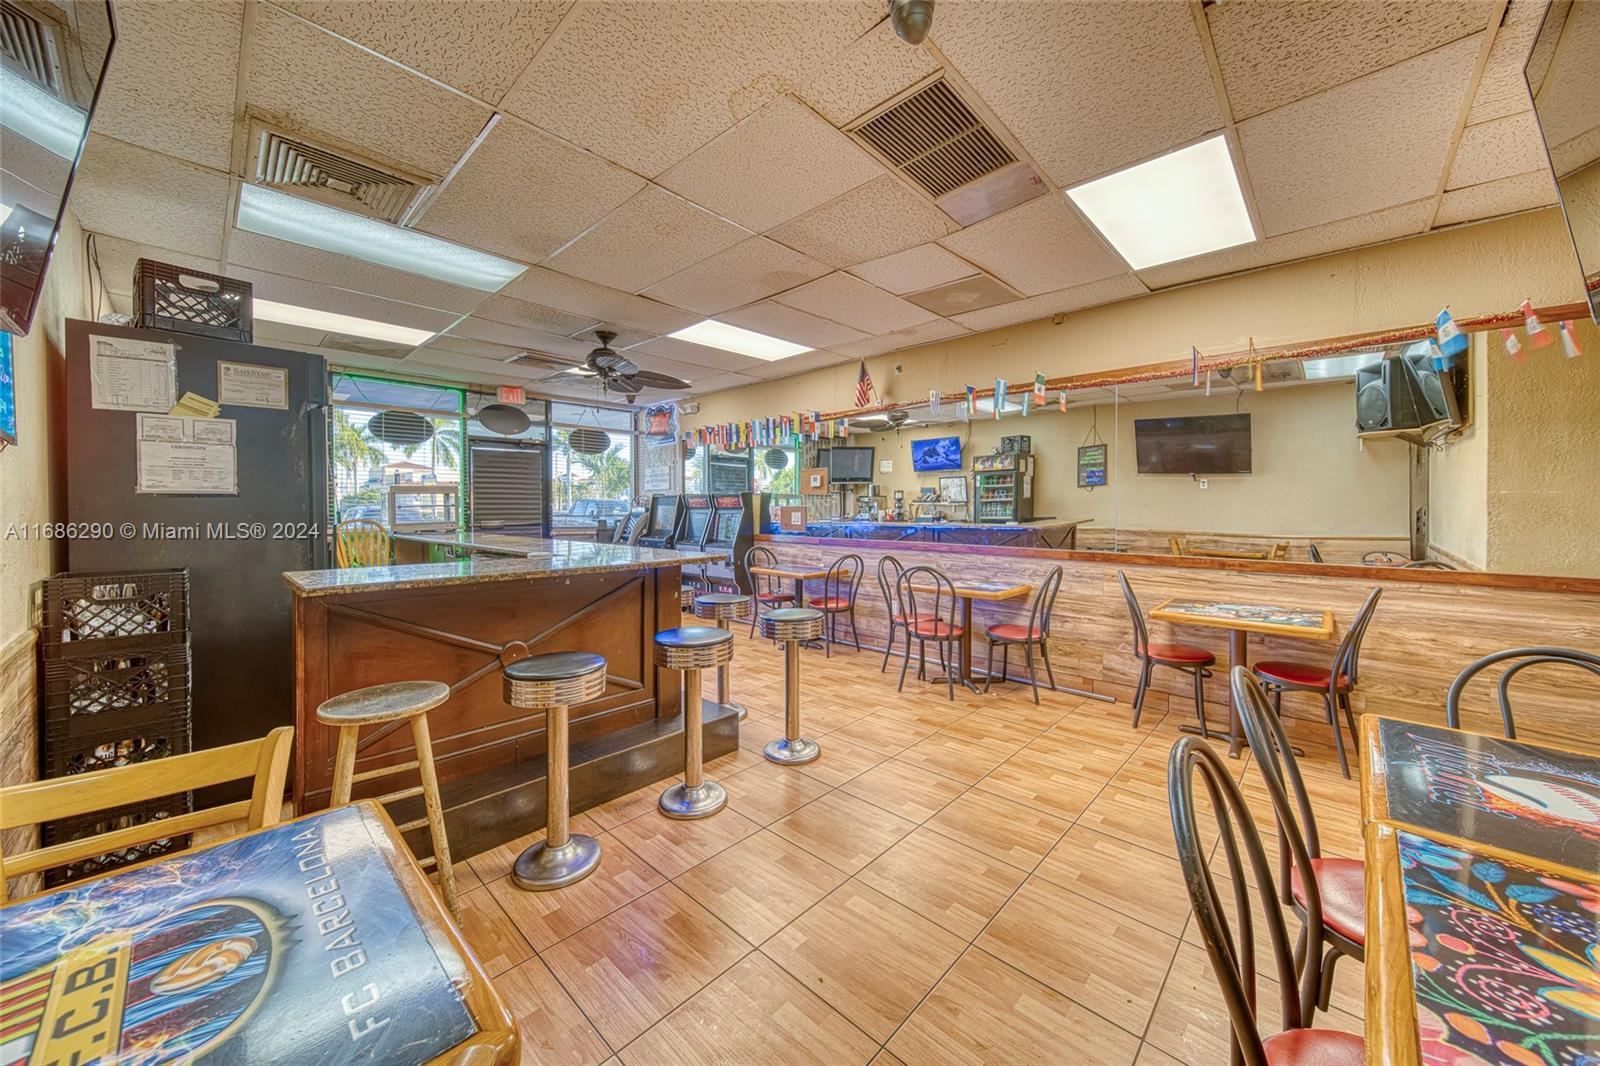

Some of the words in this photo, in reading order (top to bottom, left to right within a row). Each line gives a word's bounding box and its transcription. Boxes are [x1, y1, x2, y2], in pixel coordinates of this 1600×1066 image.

[502, 388, 521, 402] EXIT
[291, 826, 368, 979] BARCELONA
[341, 983, 391, 1042] FC
